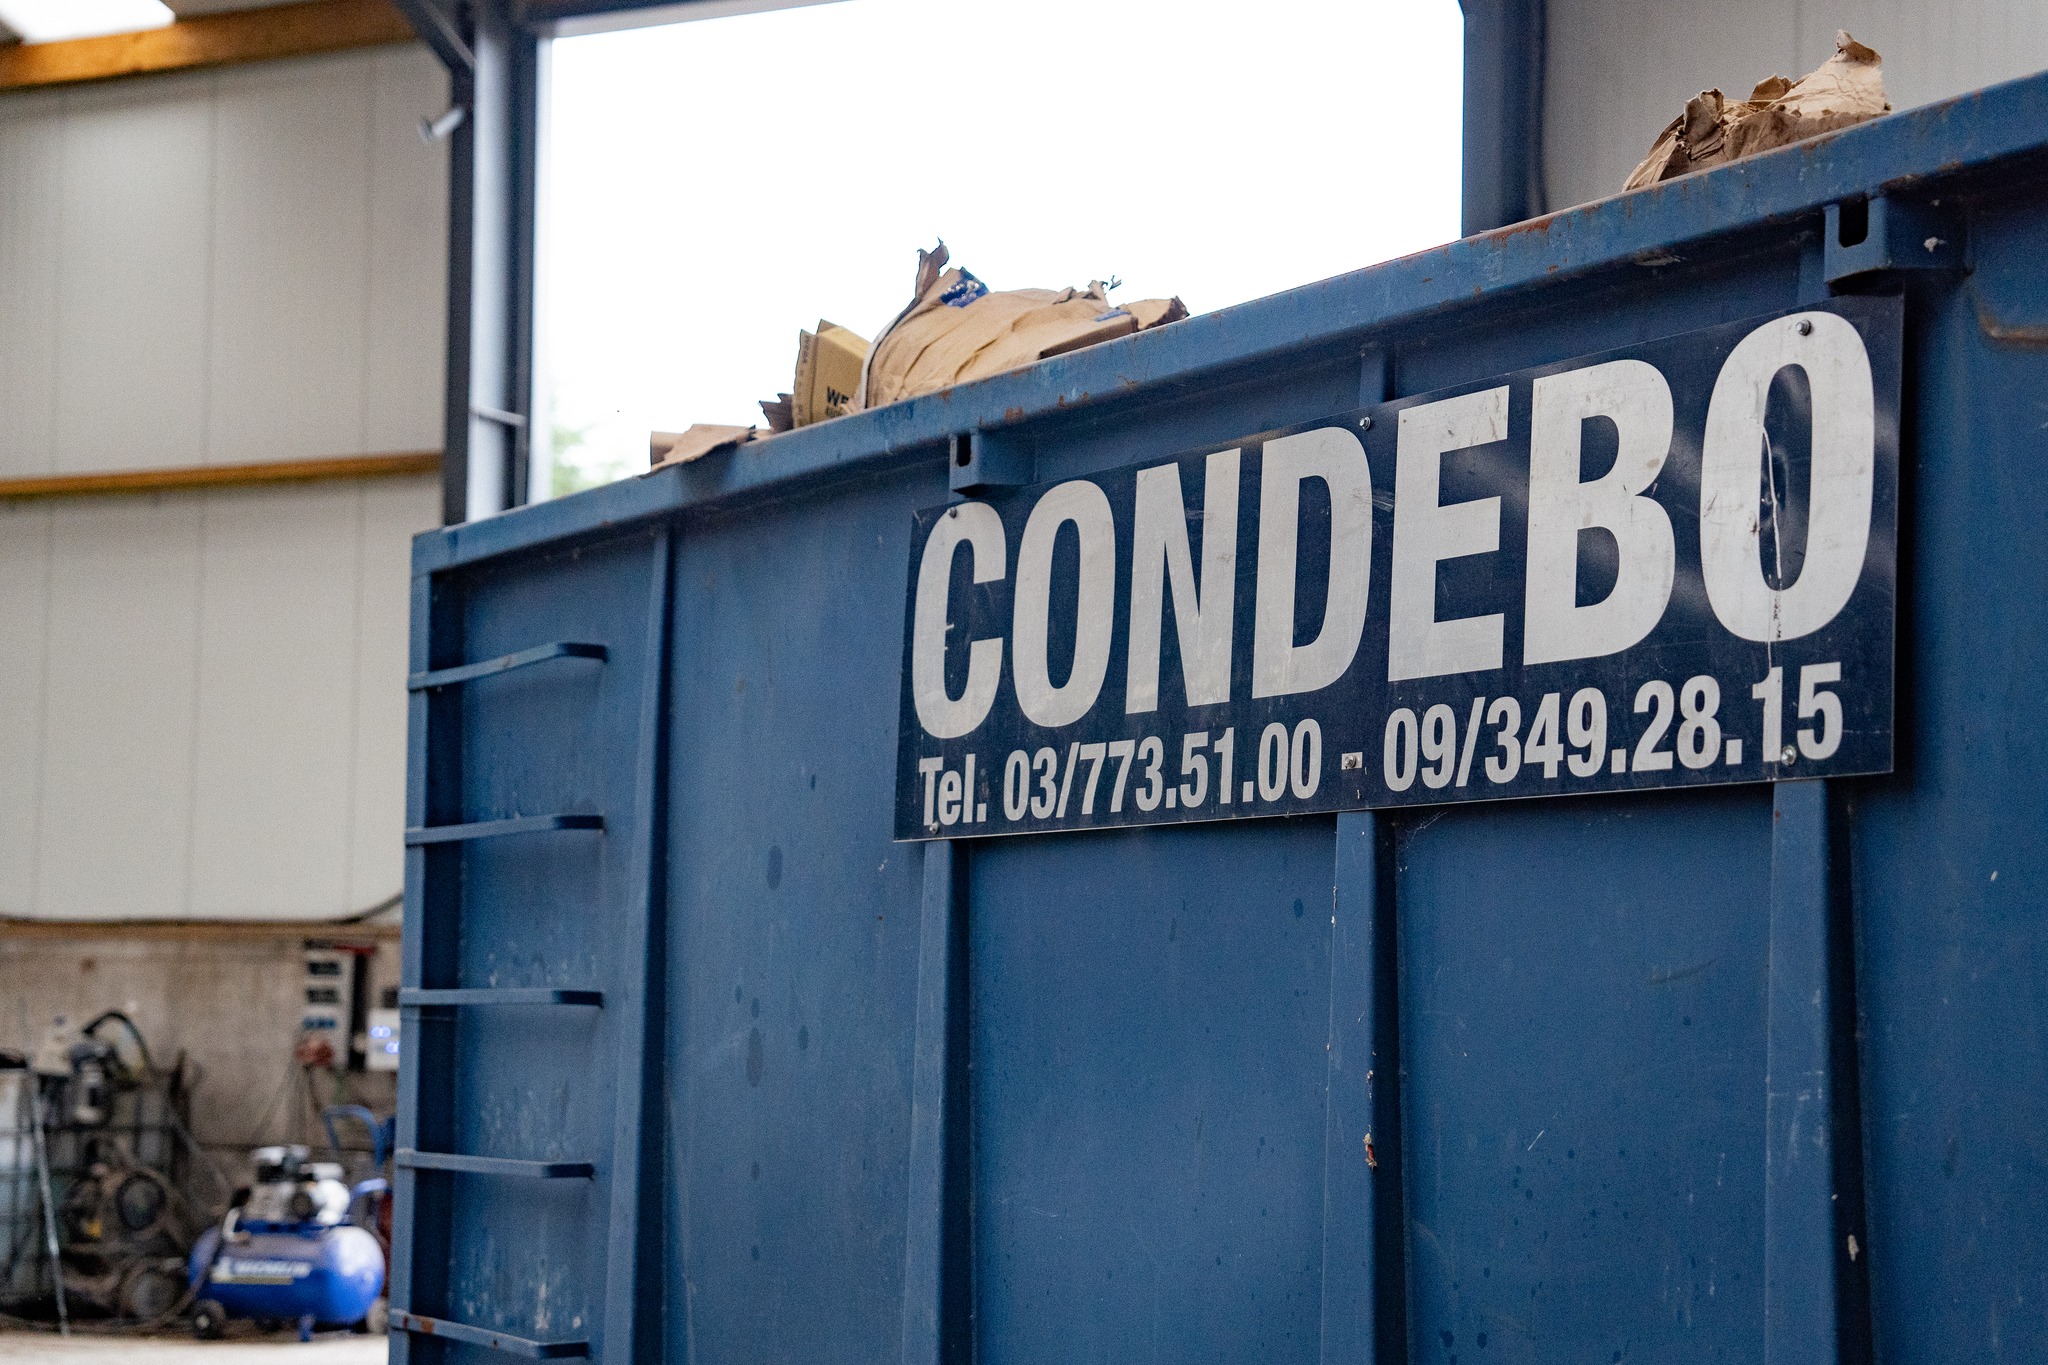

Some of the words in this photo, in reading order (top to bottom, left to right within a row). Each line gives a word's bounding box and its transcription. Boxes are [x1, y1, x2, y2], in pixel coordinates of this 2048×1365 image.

[913, 311, 1876, 739] CONDEBO
[918, 754, 987, 826] Tel.
[1003, 718, 1322, 822] 03/773.51.00
[1383, 661, 1844, 792] 09/349.28.15
